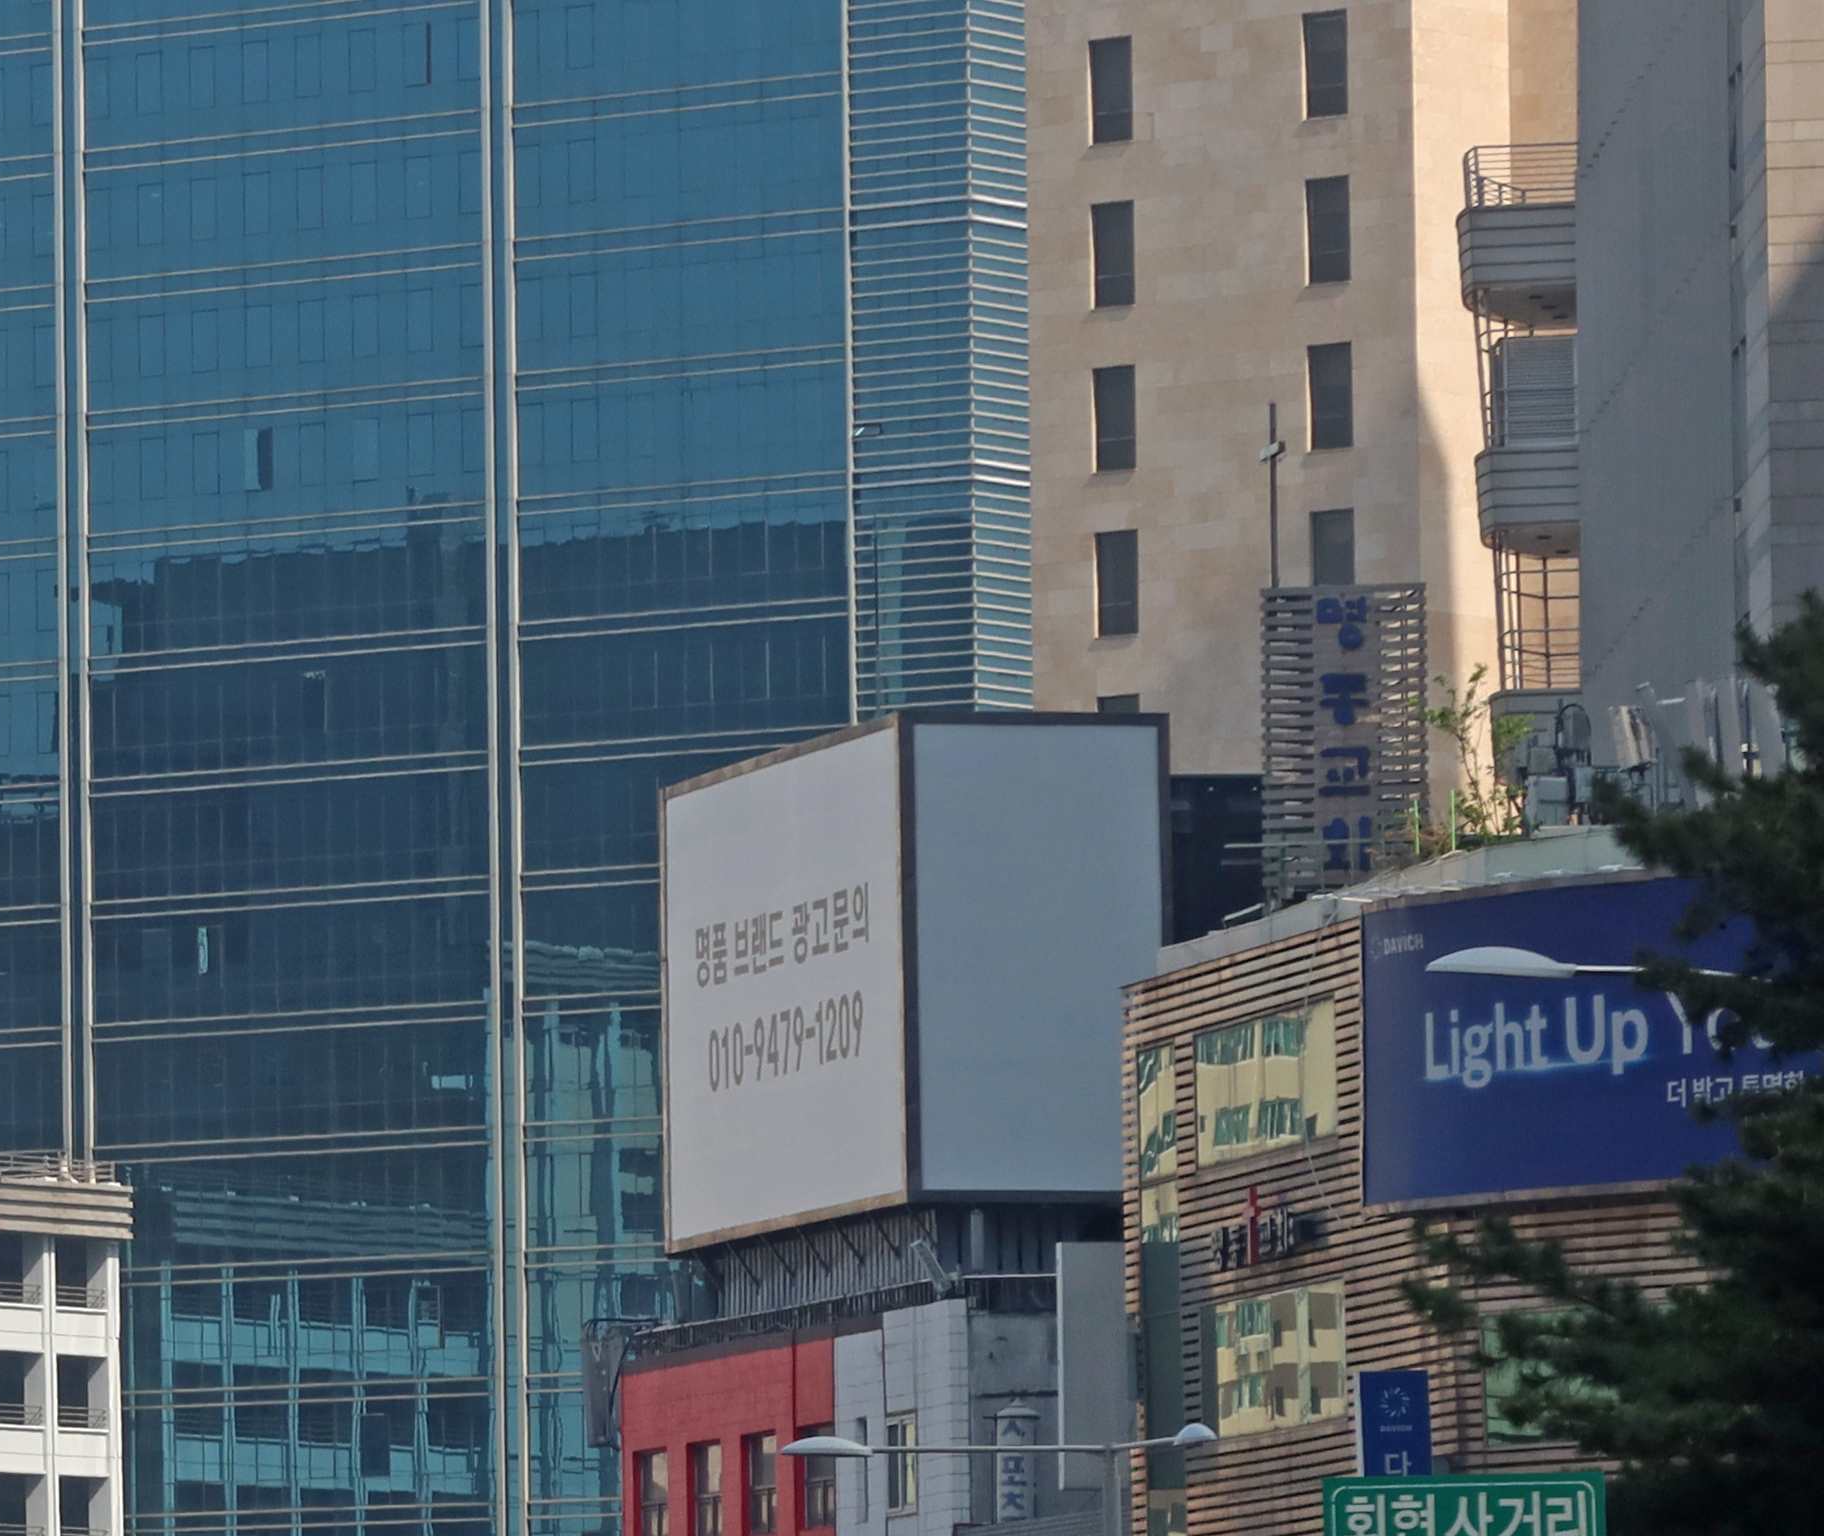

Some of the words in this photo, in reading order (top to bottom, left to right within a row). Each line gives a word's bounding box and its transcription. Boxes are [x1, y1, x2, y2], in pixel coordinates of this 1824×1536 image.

[1316, 596, 1372, 872] 명동교회
[696, 921, 727, 988] 명품
[734, 910, 784, 976] 브랜드
[792, 881, 870, 965] 광고문의
[1383, 934, 1424, 954] DAVICH
[708, 989, 863, 1093] 010-9479-1209
[1425, 1002, 1548, 1089] Light
[1565, 994, 1648, 1075] Up
[1667, 1077, 1686, 1108] 더
